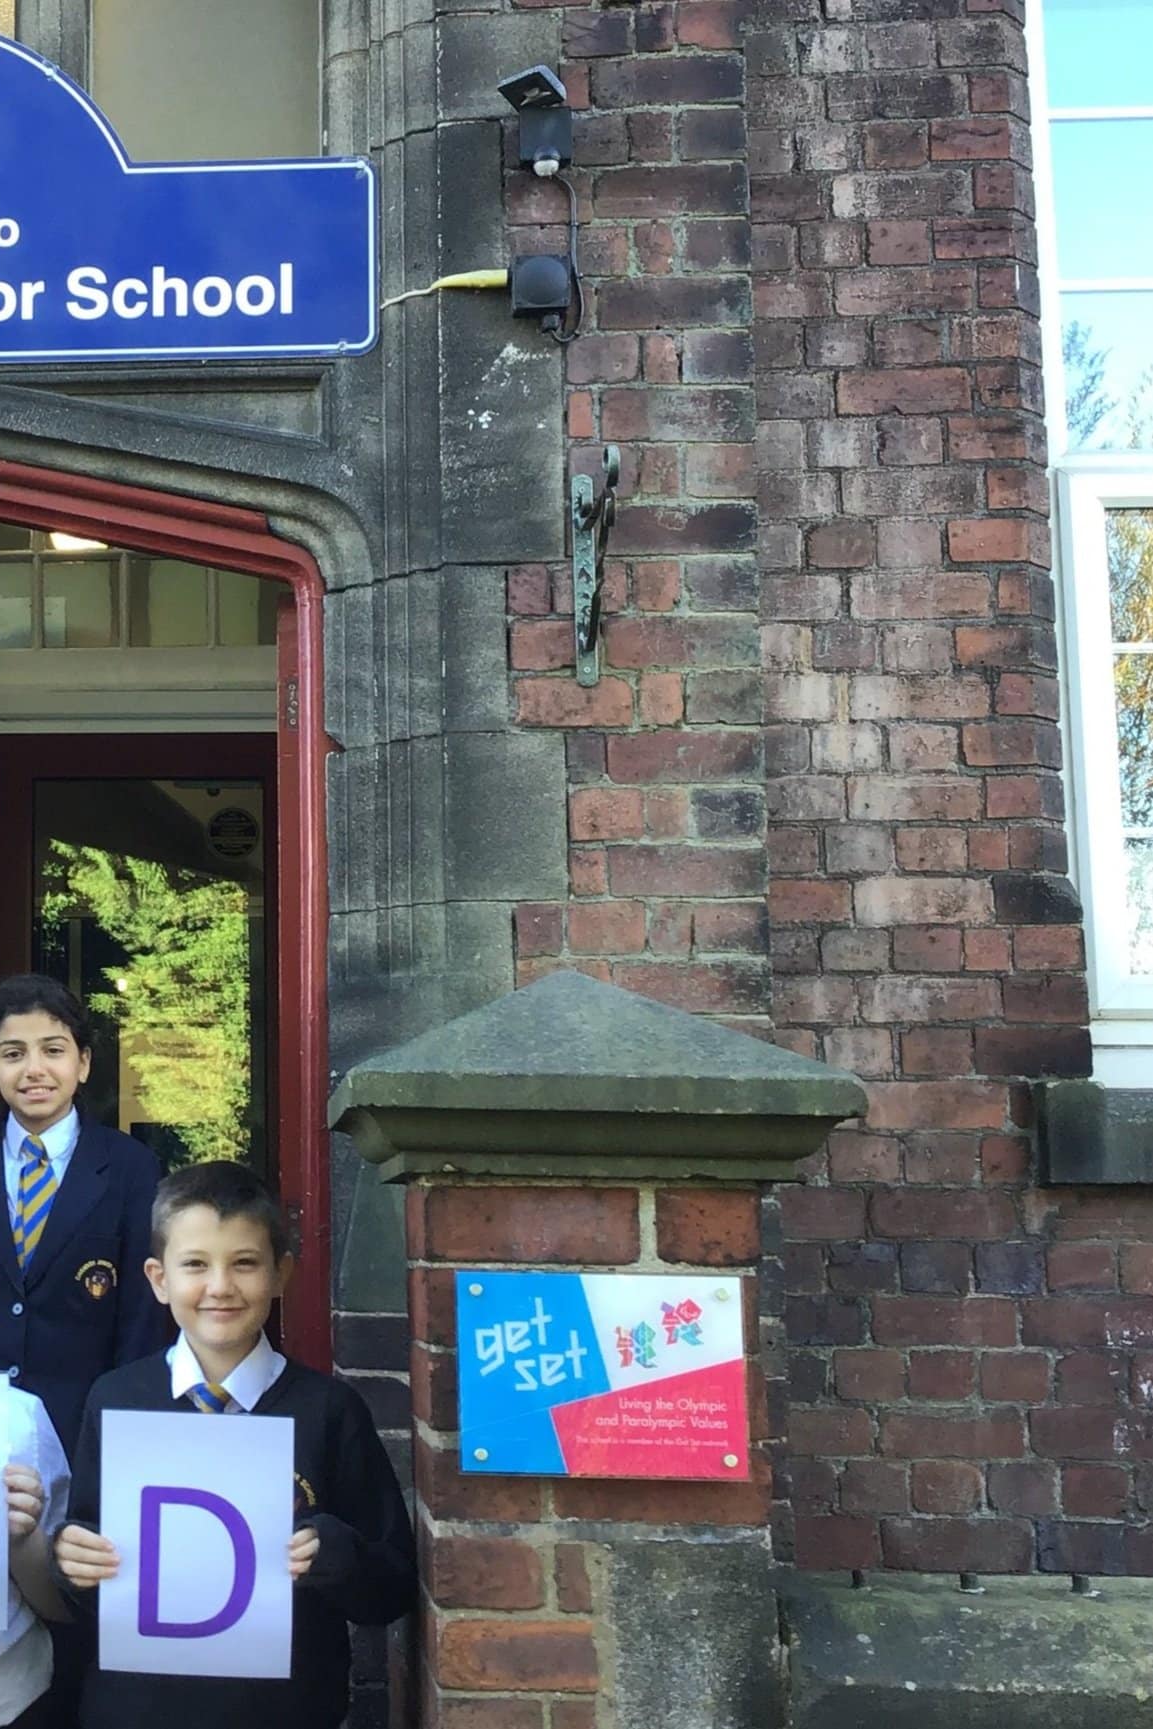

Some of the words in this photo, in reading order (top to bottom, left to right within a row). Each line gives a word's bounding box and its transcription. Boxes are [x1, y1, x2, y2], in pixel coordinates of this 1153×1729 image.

[65, 264, 295, 317] School
[475, 1297, 552, 1376] get
[514, 1330, 587, 1391] set
[596, 1415, 618, 1426] and
[622, 1415, 686, 1431] Paralympic
[690, 1415, 728, 1429] Values
[619, 1399, 651, 1413] Living
[655, 1399, 674, 1411] the
[677, 1400, 727, 1415] Olympic
